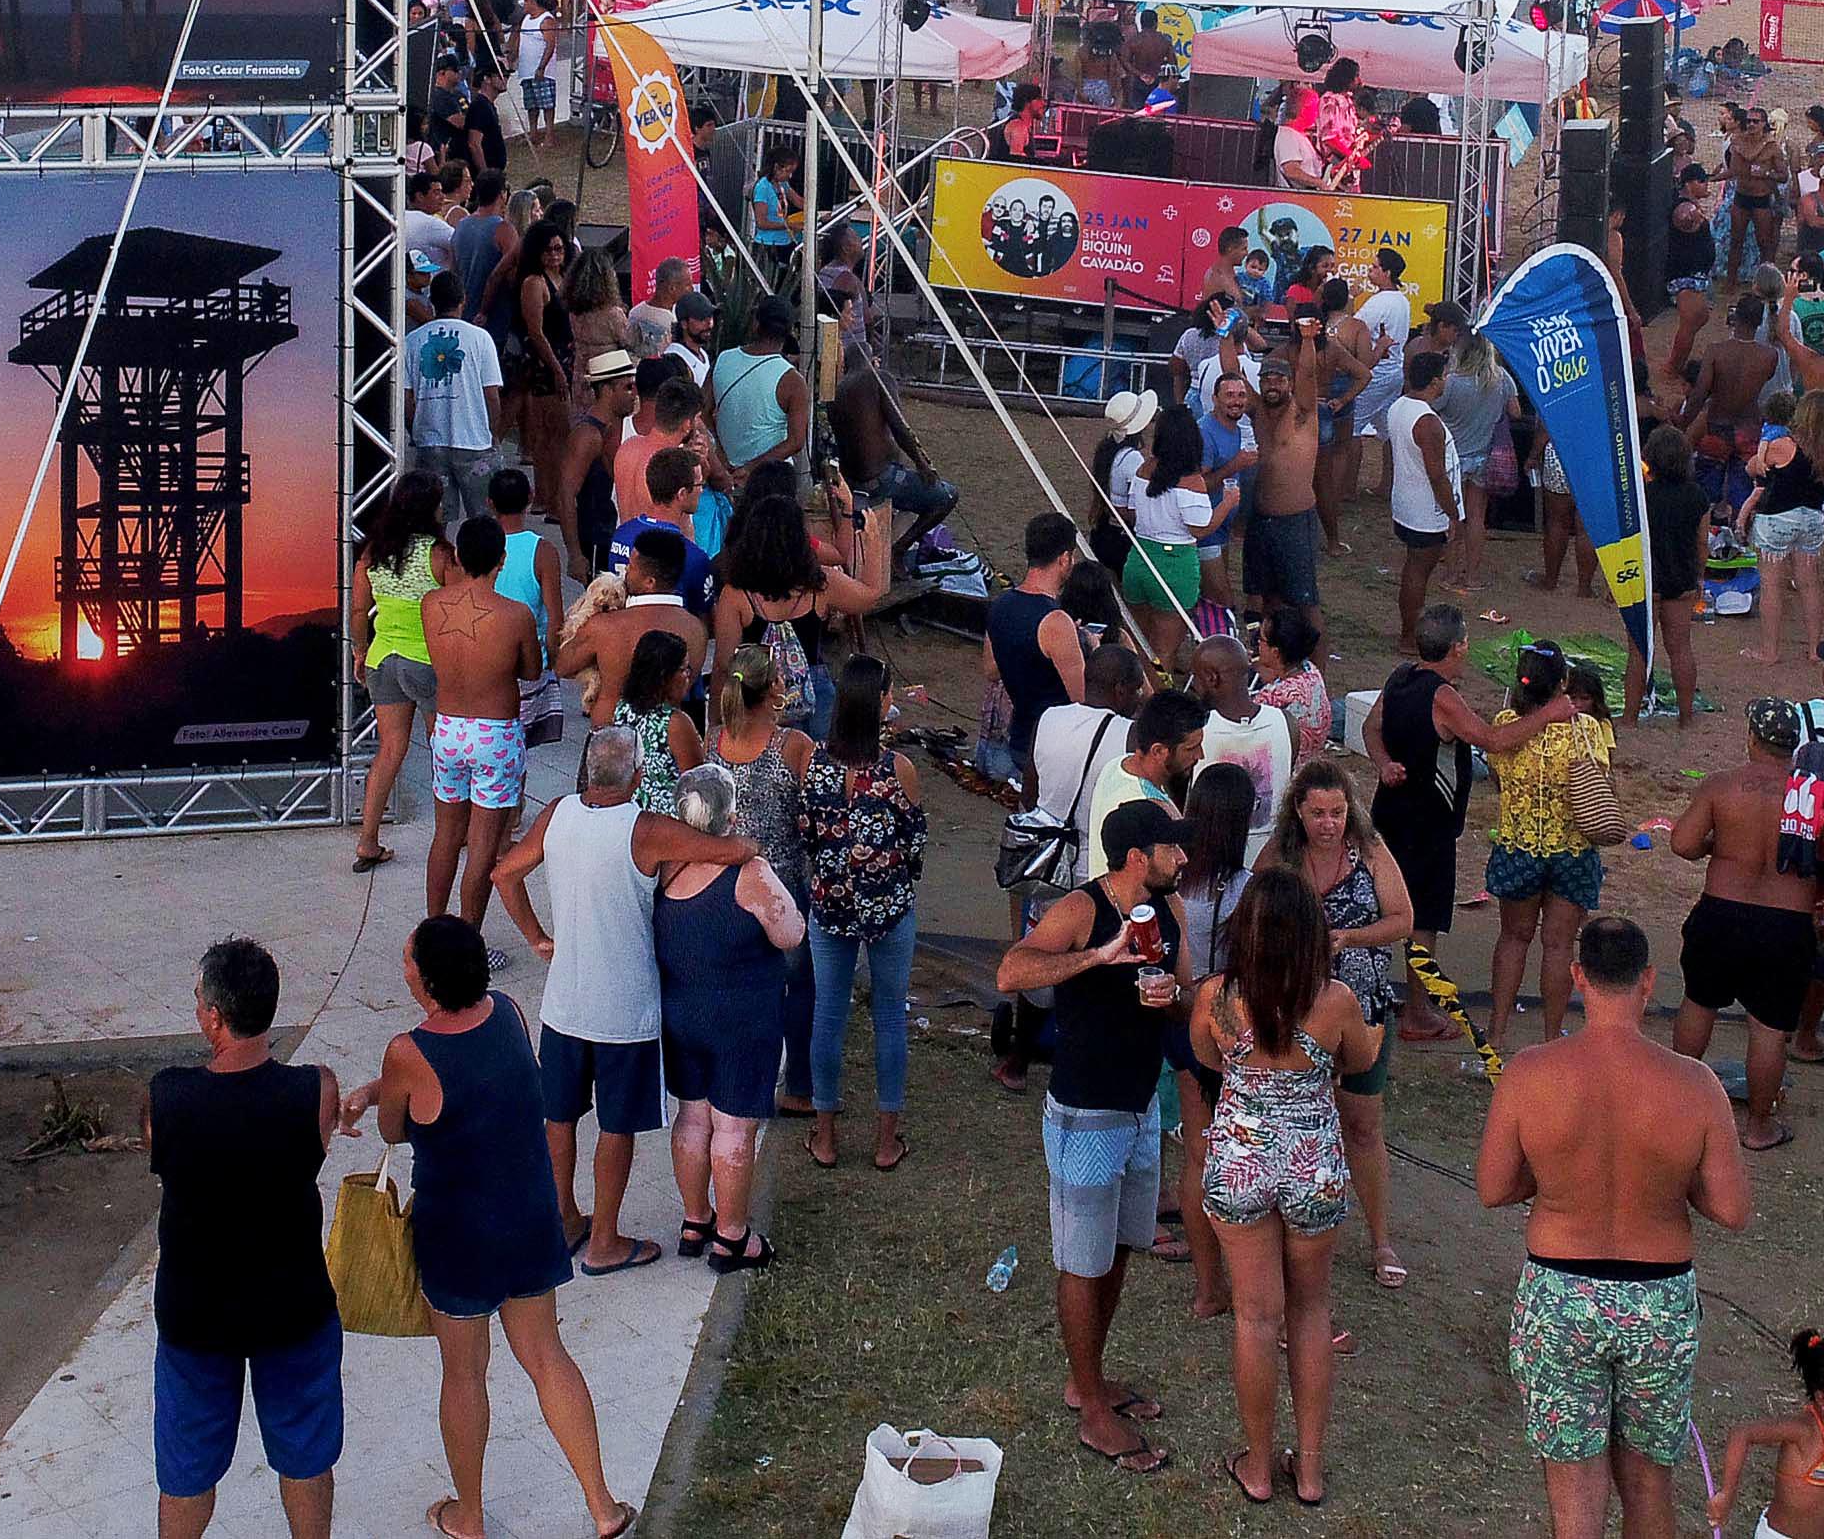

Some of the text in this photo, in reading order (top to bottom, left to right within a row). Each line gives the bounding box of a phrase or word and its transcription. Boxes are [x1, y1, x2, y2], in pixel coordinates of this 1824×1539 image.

[183, 65, 300, 75] Foto: Cezar Fernandes
[1084, 212, 1149, 230] 25 JAN
[1083, 229, 1123, 241] SHOW
[1339, 228, 1411, 247] 27 JAN
[1082, 240, 1132, 255] BIQUINI
[1080, 256, 1144, 273] CAVADÃO
[1529, 327, 1583, 366] VIVER
[1537, 355, 1589, 394] O Sesc
